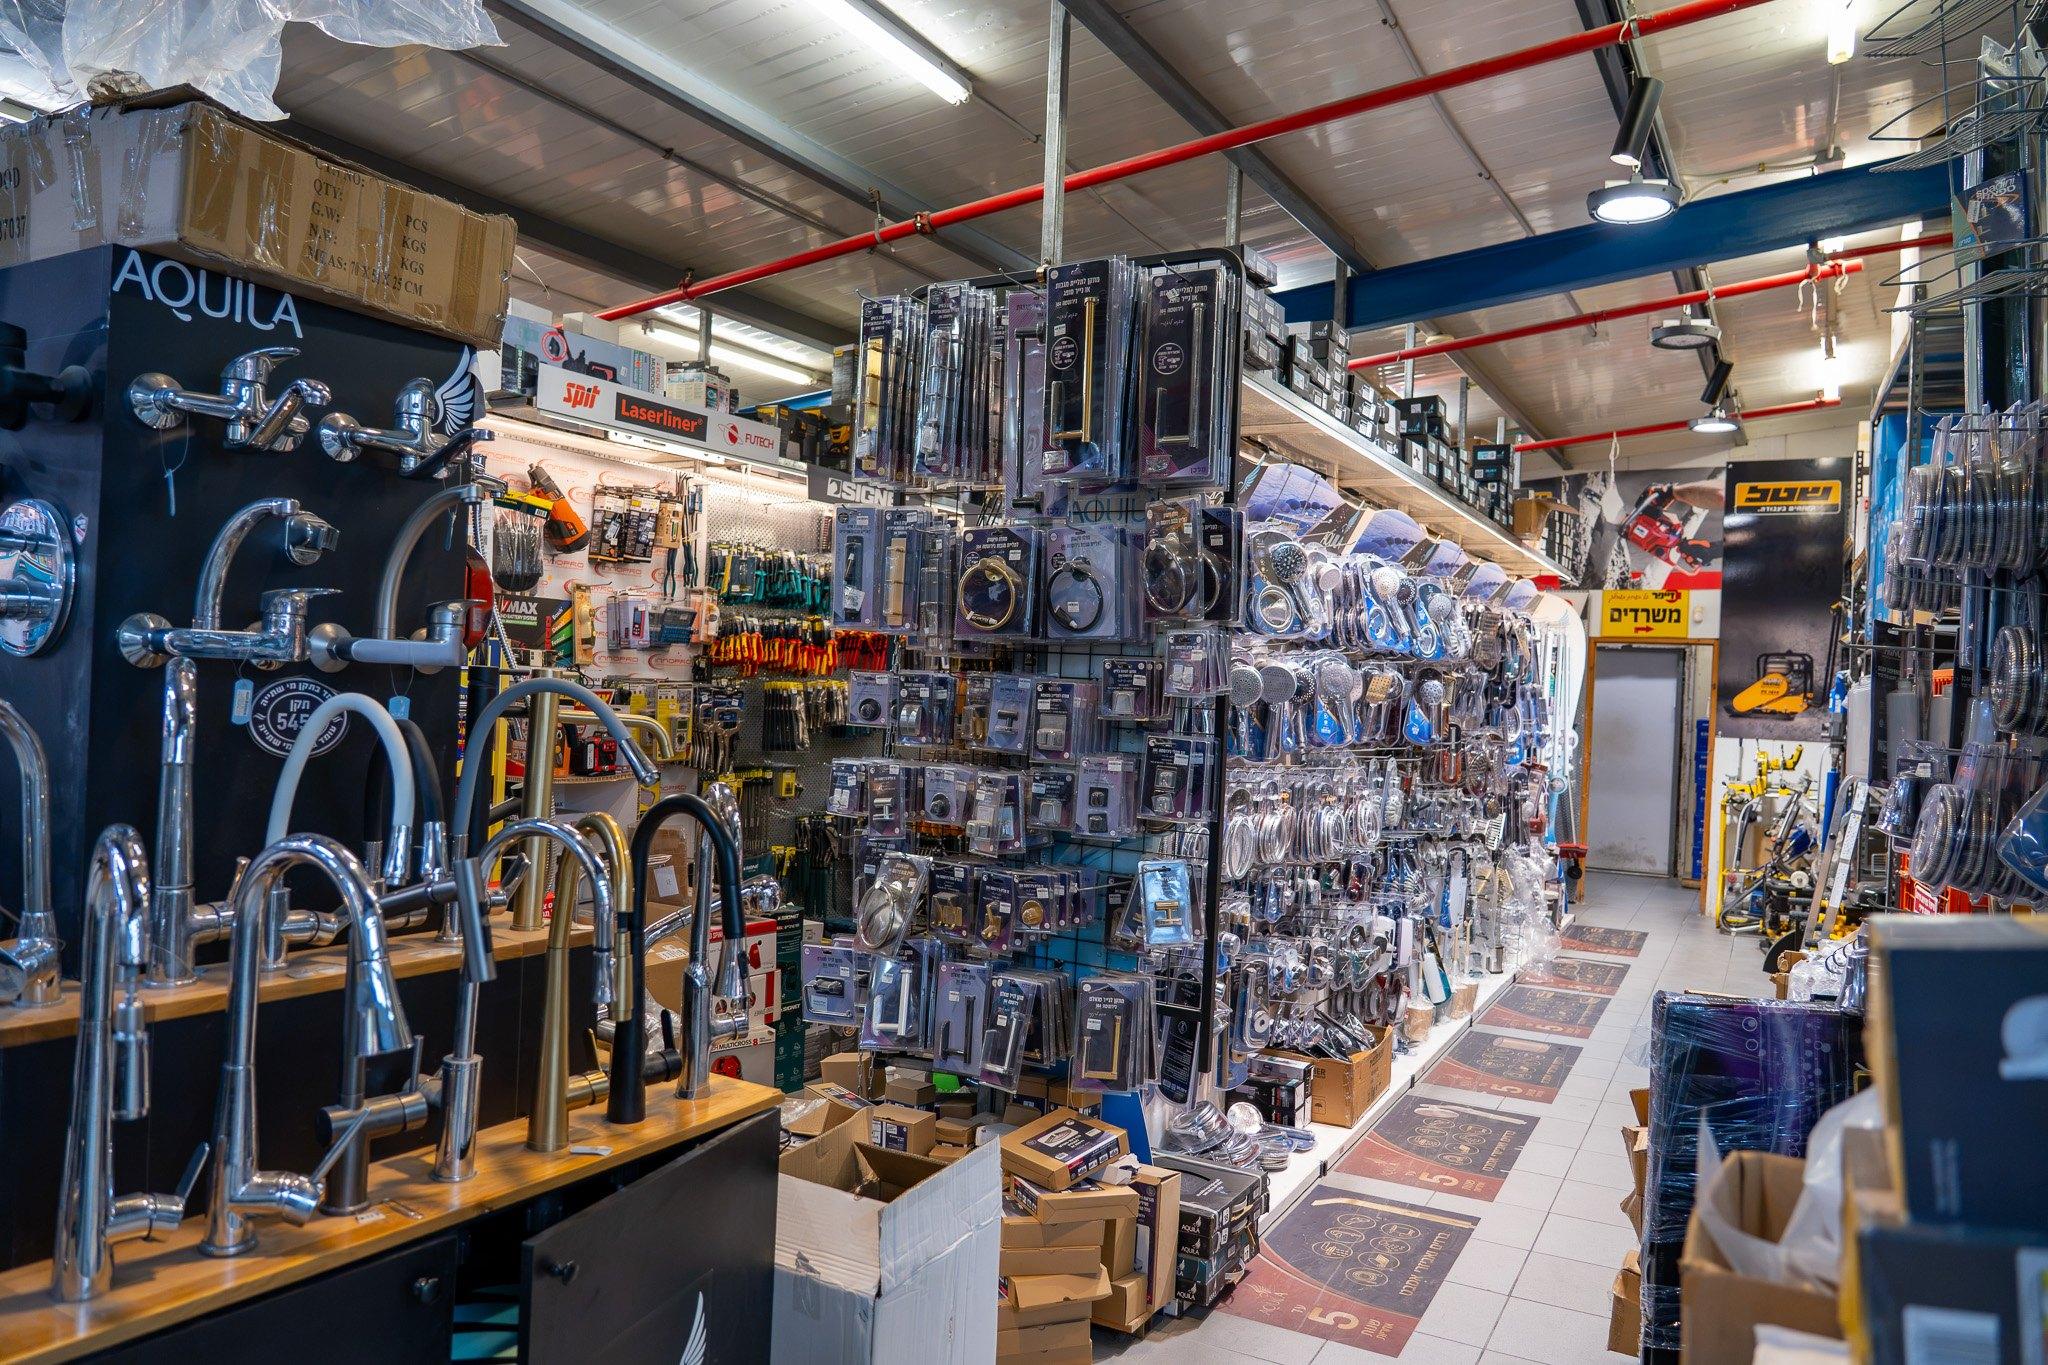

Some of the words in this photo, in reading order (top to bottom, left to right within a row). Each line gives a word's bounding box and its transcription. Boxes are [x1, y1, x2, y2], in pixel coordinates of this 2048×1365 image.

[314, 178, 342, 200] QTY:
[312, 202, 340, 224] G.W:
[404, 214, 428, 234] PCS
[402, 235, 427, 254] KGS
[306, 246, 346, 270] MEAS:
[404, 280, 424, 297] CM
[400, 256, 424, 276] KGS
[113, 250, 304, 339] AQUILA
[563, 382, 600, 408] spit
[744, 433, 774, 450] FUTECH
[842, 480, 895, 507] SIGNE
[1069, 498, 1146, 524] AQUIL
[1610, 608, 1682, 624] משרדים
[260, 684, 286, 708] שתייה
[298, 682, 320, 694] בתקן
[290, 700, 310, 712] תקן
[258, 723, 282, 748] שתייה
[718, 1040, 751, 1050] MULTICROSS
[752, 1038, 760, 1046] 8
[1490, 1084, 1524, 1094] 5
[1418, 1171, 1459, 1187] 5
[1181, 1224, 1200, 1234] AQUILA
[1180, 1246, 1200, 1256] AQUILA
[1429, 1232, 1451, 1250] ברזים
[1176, 1291, 1196, 1300] AQUILA
[1398, 1274, 1421, 1297] אמבט
[1290, 1304, 1307, 1314] עד
[1307, 1306, 1360, 1330] 5
[1360, 1318, 1380, 1338] שנות
